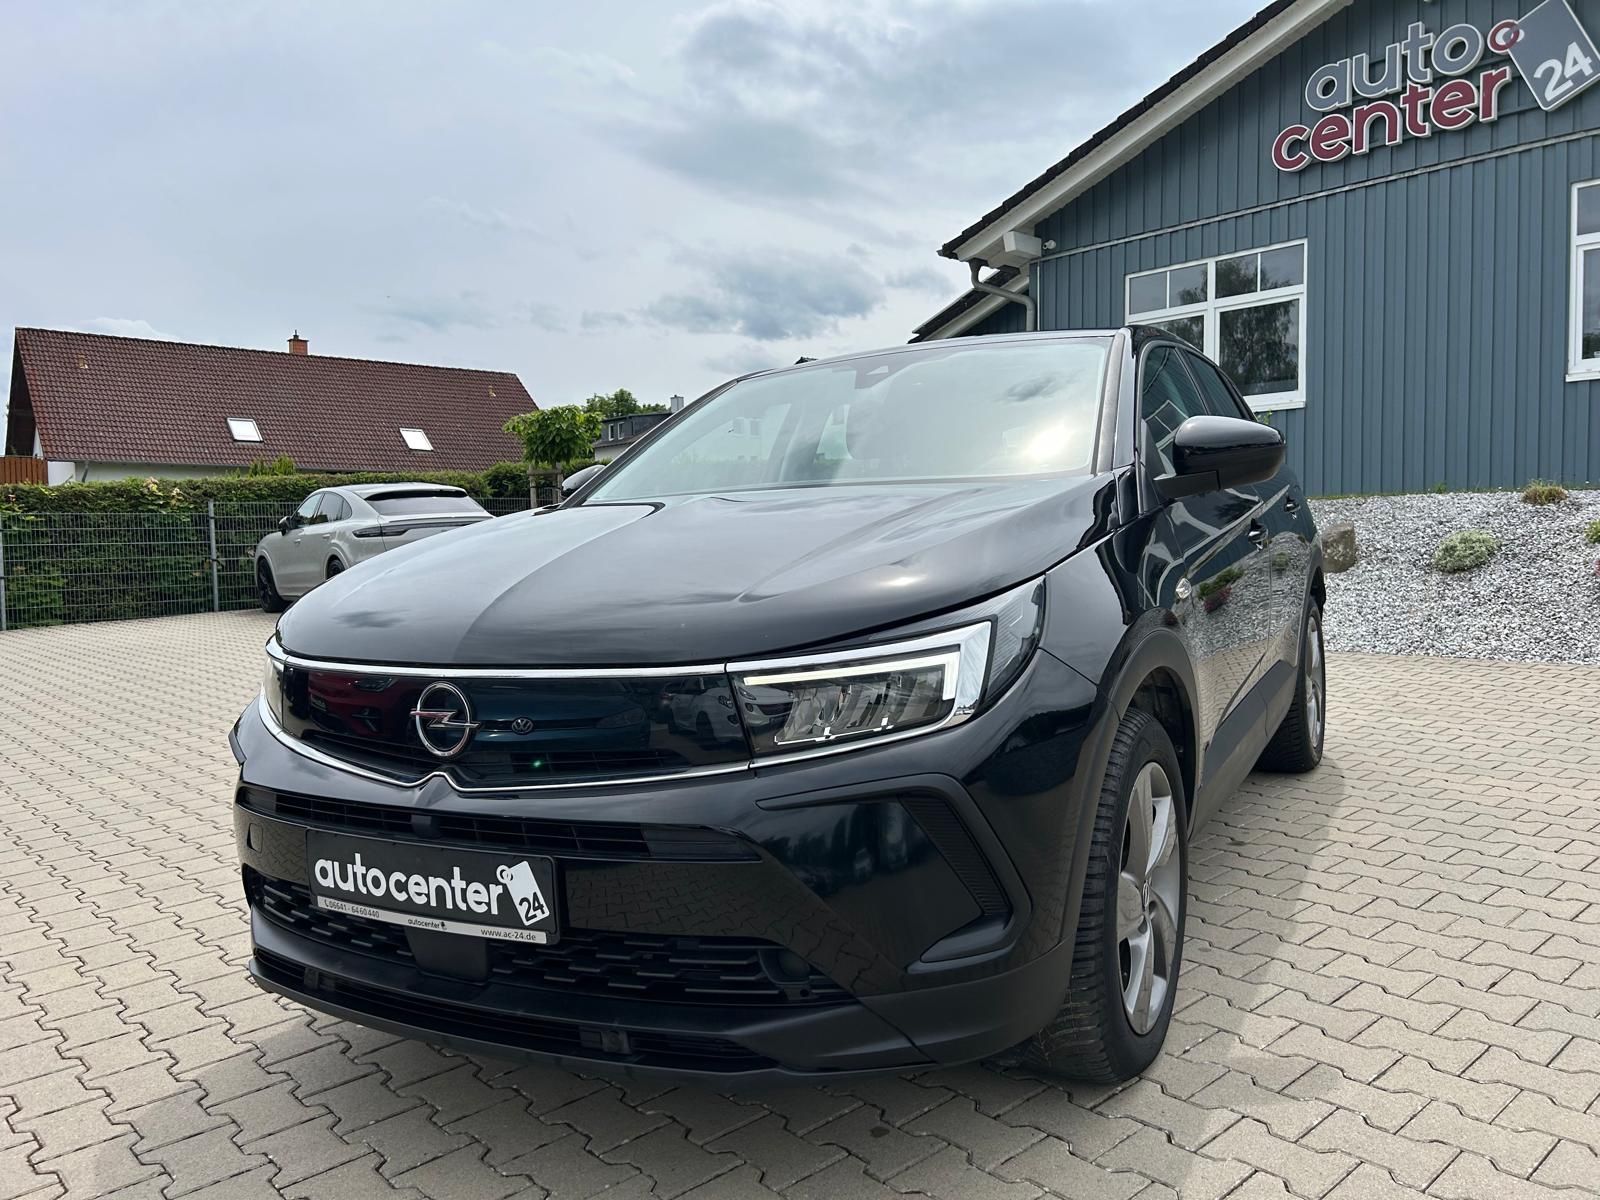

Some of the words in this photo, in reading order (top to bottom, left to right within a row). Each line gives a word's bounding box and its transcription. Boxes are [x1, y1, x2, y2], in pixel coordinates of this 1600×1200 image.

[1305, 22, 1484, 112] auto
[1533, 41, 1593, 102] 24
[1272, 66, 1511, 172] center
[407, 918, 441, 929] autocenter
[518, 891, 545, 922] 24
[480, 928, 537, 941] www.ac-24.de
